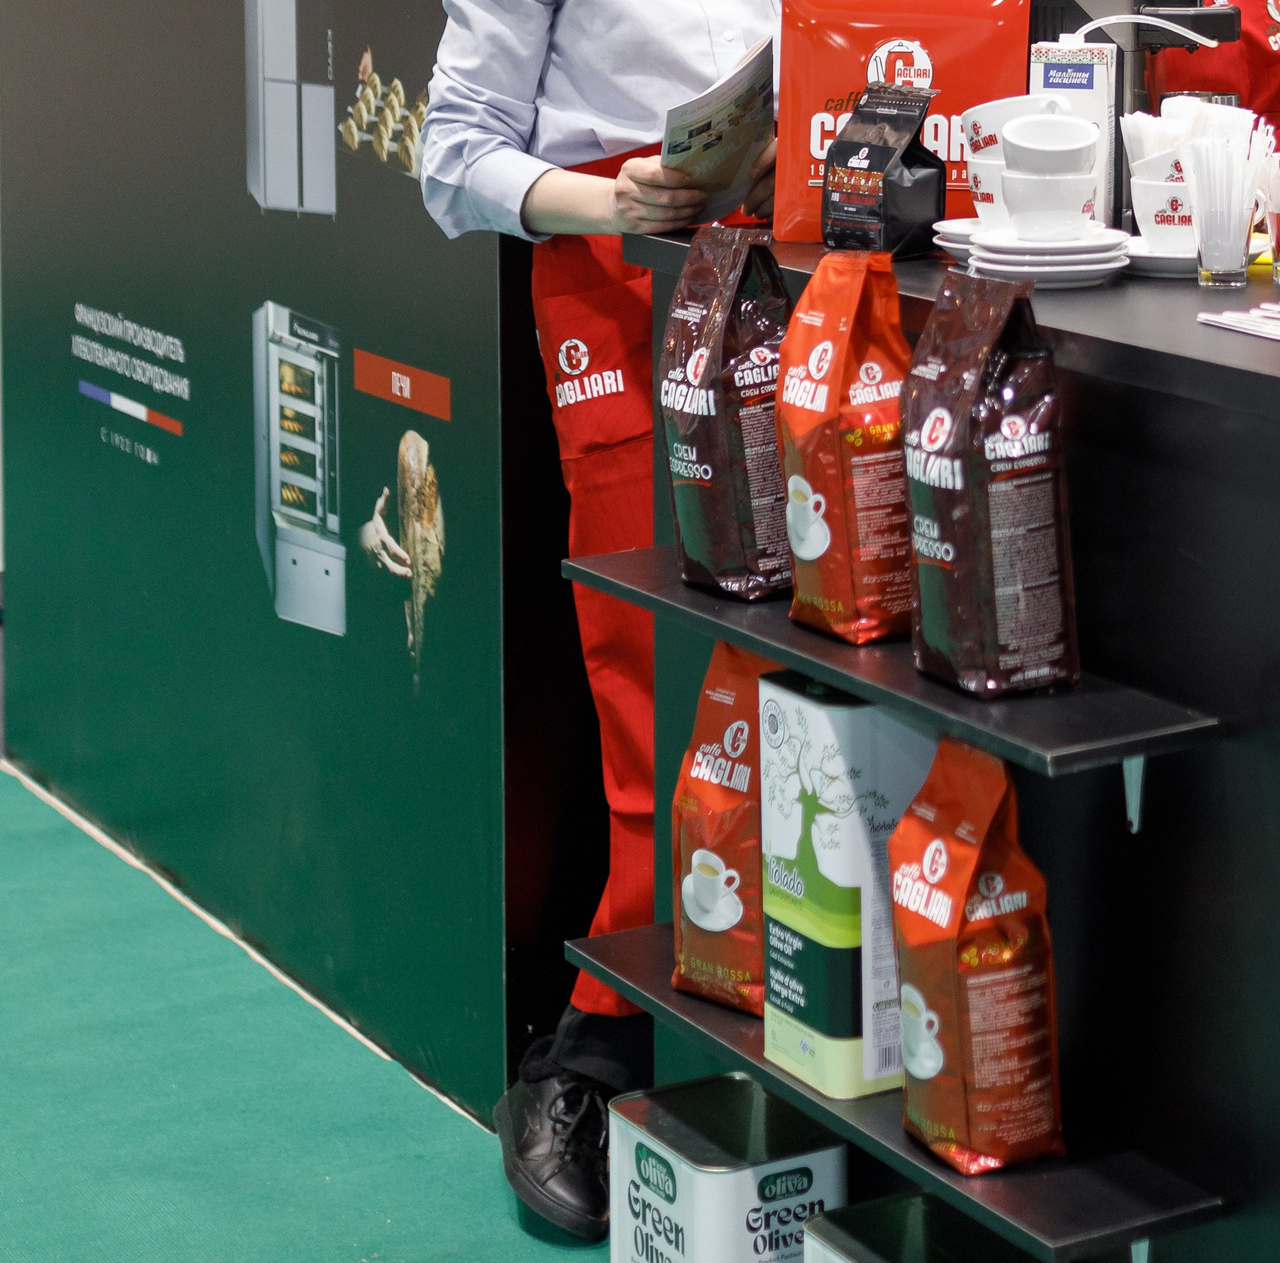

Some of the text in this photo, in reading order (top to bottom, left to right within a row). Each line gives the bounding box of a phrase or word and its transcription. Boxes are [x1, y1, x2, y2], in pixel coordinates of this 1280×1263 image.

[824, 91, 863, 112] caff
[1154, 213, 1193, 227] CAGLIAR
[555, 369, 625, 408] AGLIARI
[734, 364, 780, 388] CAGLIA
[661, 380, 717, 416] CAGLARI
[848, 380, 904, 406] CAGLIAR
[673, 443, 697, 462] CREM
[905, 446, 964, 491] AGLIARI
[914, 515, 940, 540] CREM
[912, 533, 956, 562] PRESSO
[700, 743, 723, 757] caffè
[690, 750, 751, 794] CAGLIARI
[900, 862, 921, 880] caffè
[627, 1179, 686, 1259] Green
[745, 1198, 825, 1235] Green
